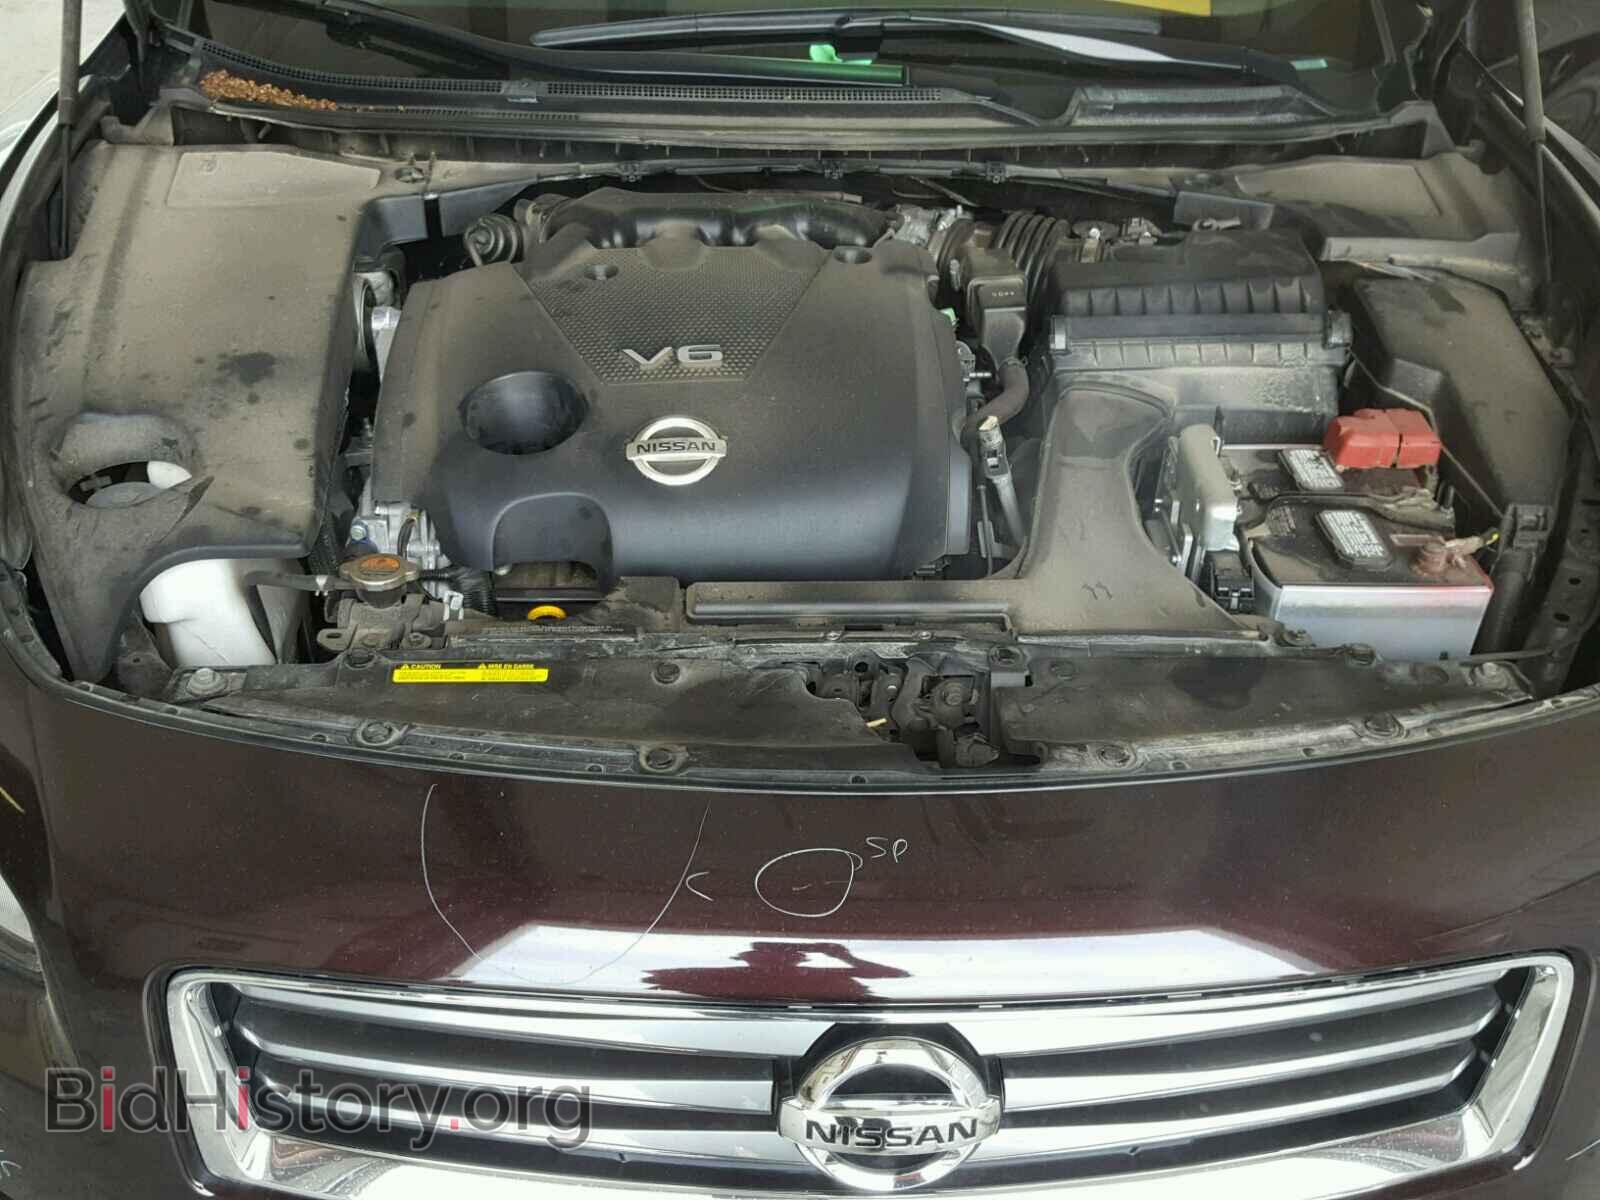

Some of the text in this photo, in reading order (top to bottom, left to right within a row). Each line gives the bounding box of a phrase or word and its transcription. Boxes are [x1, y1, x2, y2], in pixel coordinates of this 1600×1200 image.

[622, 344, 723, 367] V6
[636, 441, 716, 454] NISSAN
[805, 1118, 977, 1147] NISSAN
